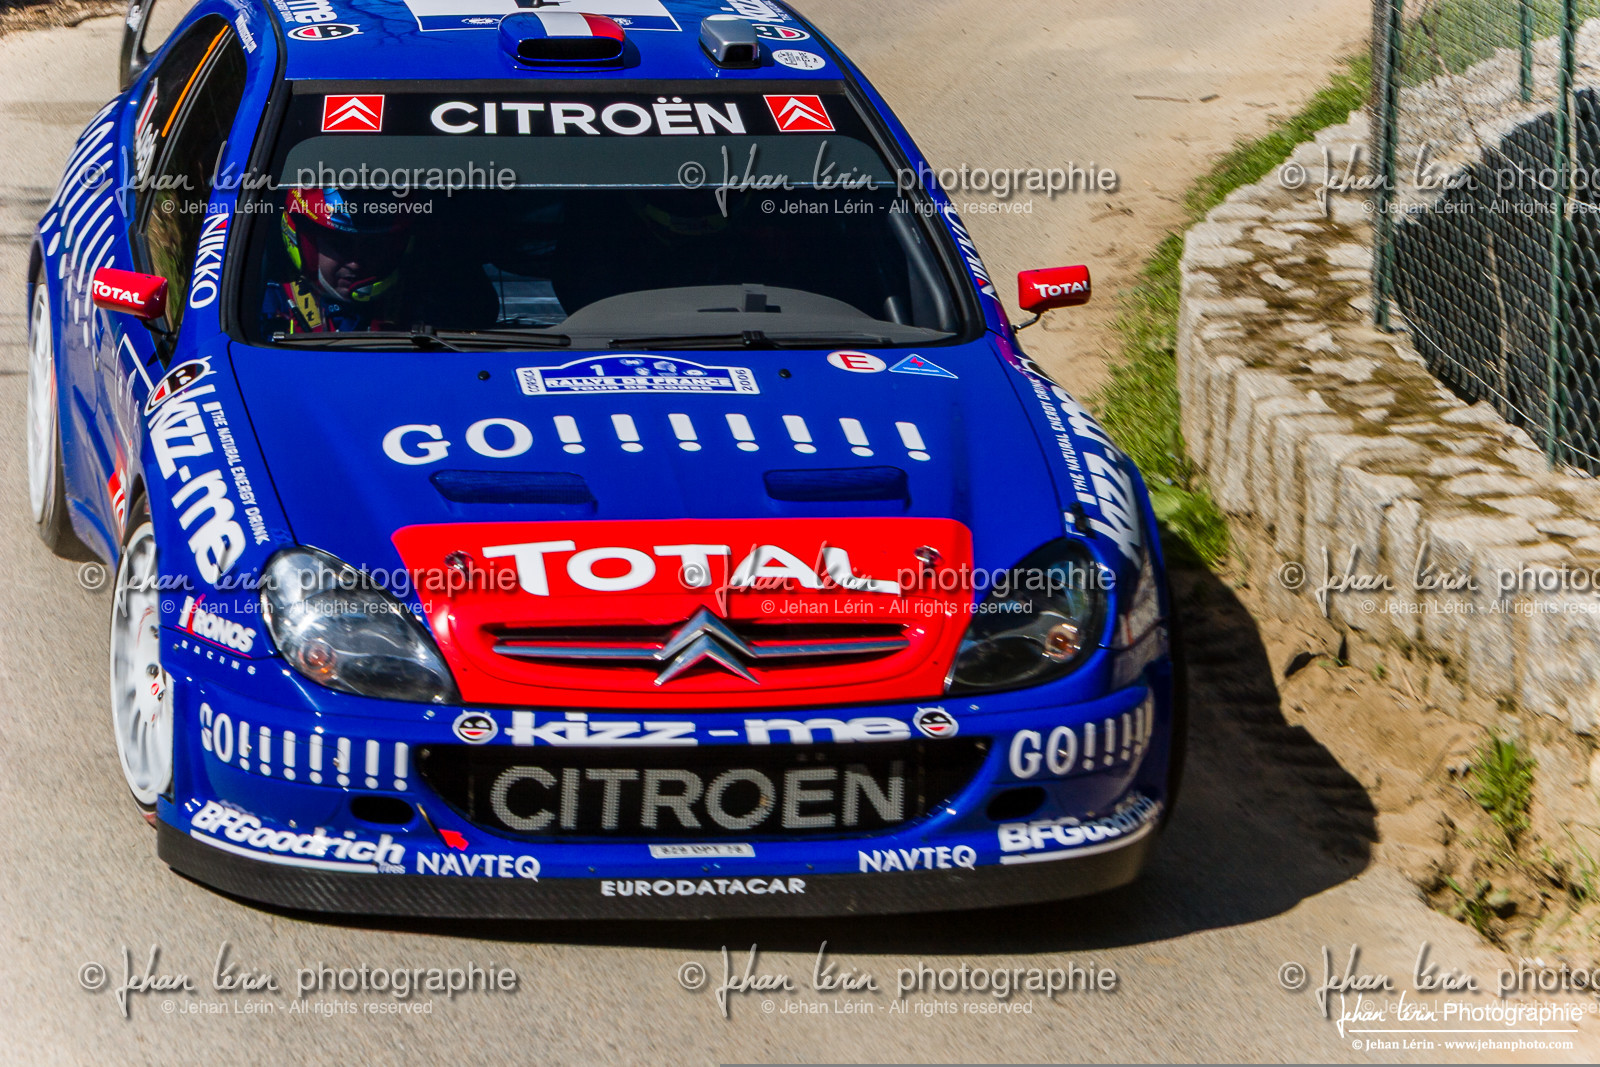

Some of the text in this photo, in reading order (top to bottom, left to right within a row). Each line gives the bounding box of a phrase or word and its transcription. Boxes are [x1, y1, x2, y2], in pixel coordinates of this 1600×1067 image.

[430, 95, 747, 136] CITROËN
[189, 212, 230, 309] NIKKO
[93, 280, 146, 305] TOTAL
[1032, 280, 1091, 298] TOTAL
[589, 364, 605, 377] 1
[842, 353, 875, 371] E
[545, 377, 734, 388] RALLYE DE FRANCE
[741, 368, 758, 392] 2006
[1055, 433, 1083, 472] NATURAL
[149, 384, 247, 584] kizz-me
[210, 408, 271, 546] THE NATURAL ENERGY DRINK
[1069, 472, 1090, 492] THE
[482, 540, 900, 597] TOTAL
[489, 752, 905, 831] CITROËN
[189, 799, 406, 866] BFGoodrich
[416, 850, 542, 883] NAVTEQ
[857, 843, 978, 874] NAVTEQ
[600, 877, 807, 898] EURODATACAR
